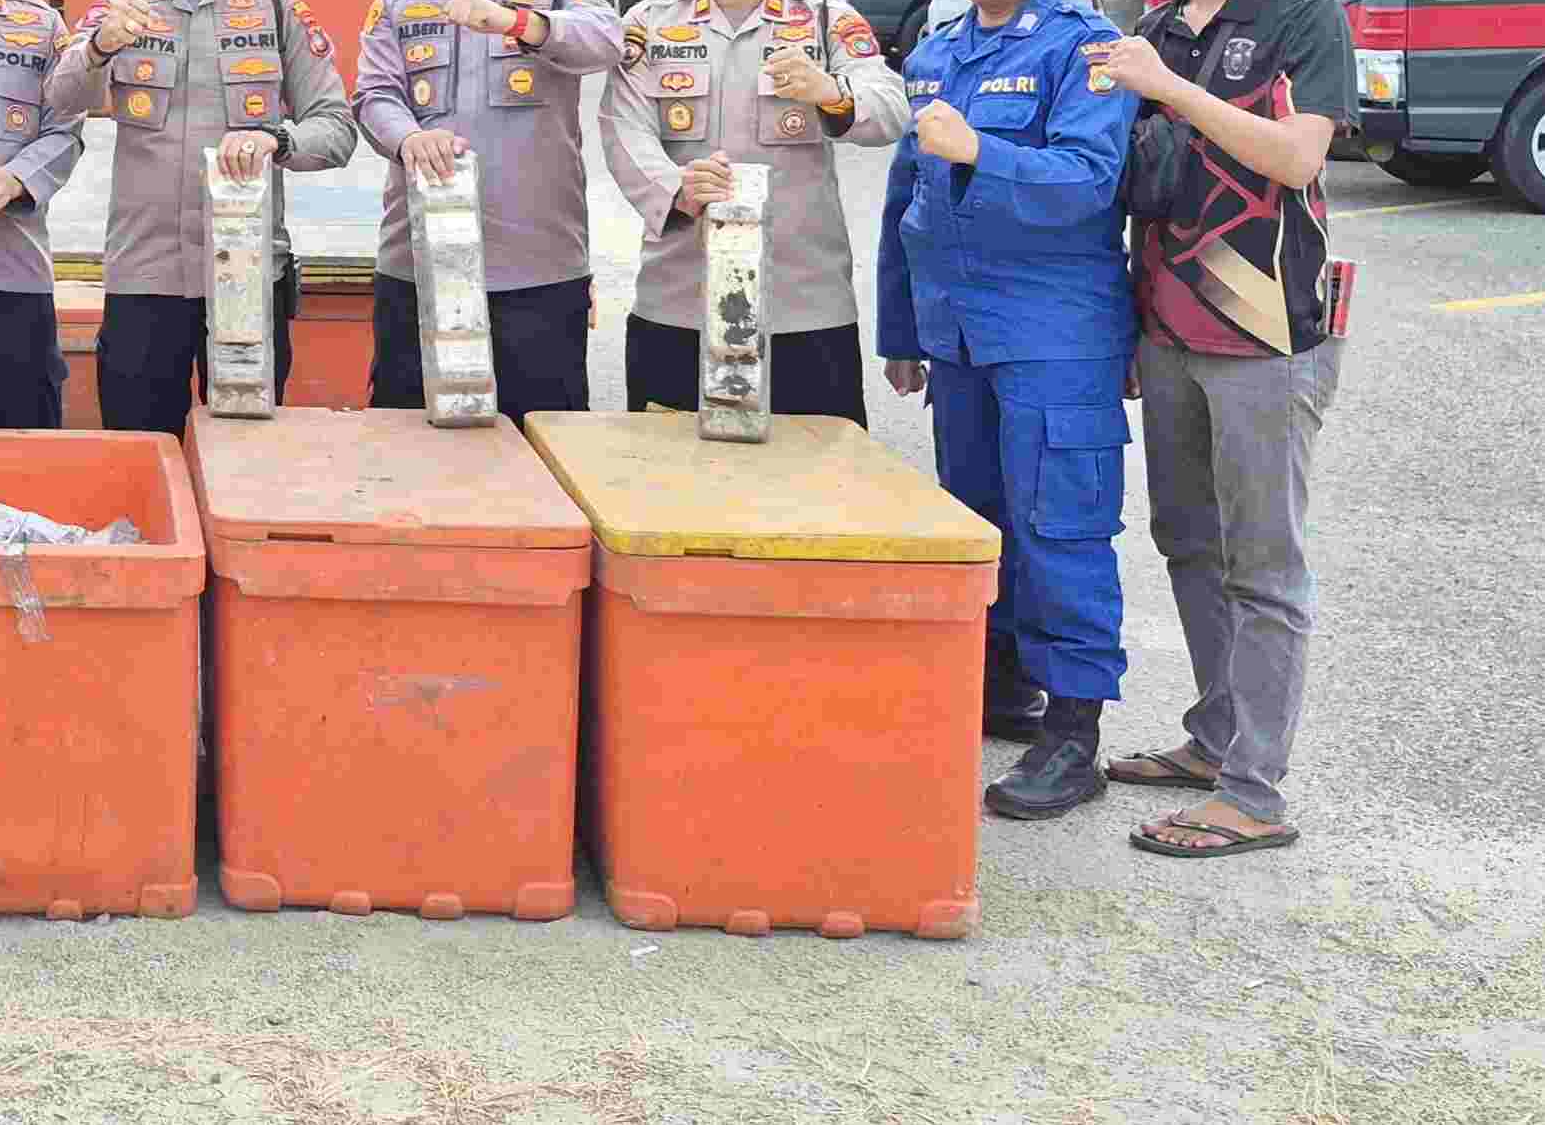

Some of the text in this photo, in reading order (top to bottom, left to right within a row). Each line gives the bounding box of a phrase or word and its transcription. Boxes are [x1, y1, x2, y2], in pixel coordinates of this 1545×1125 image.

[133, 34, 175, 54] DITYA
[221, 33, 275, 51] POLRI
[981, 76, 1035, 94] POLRI
